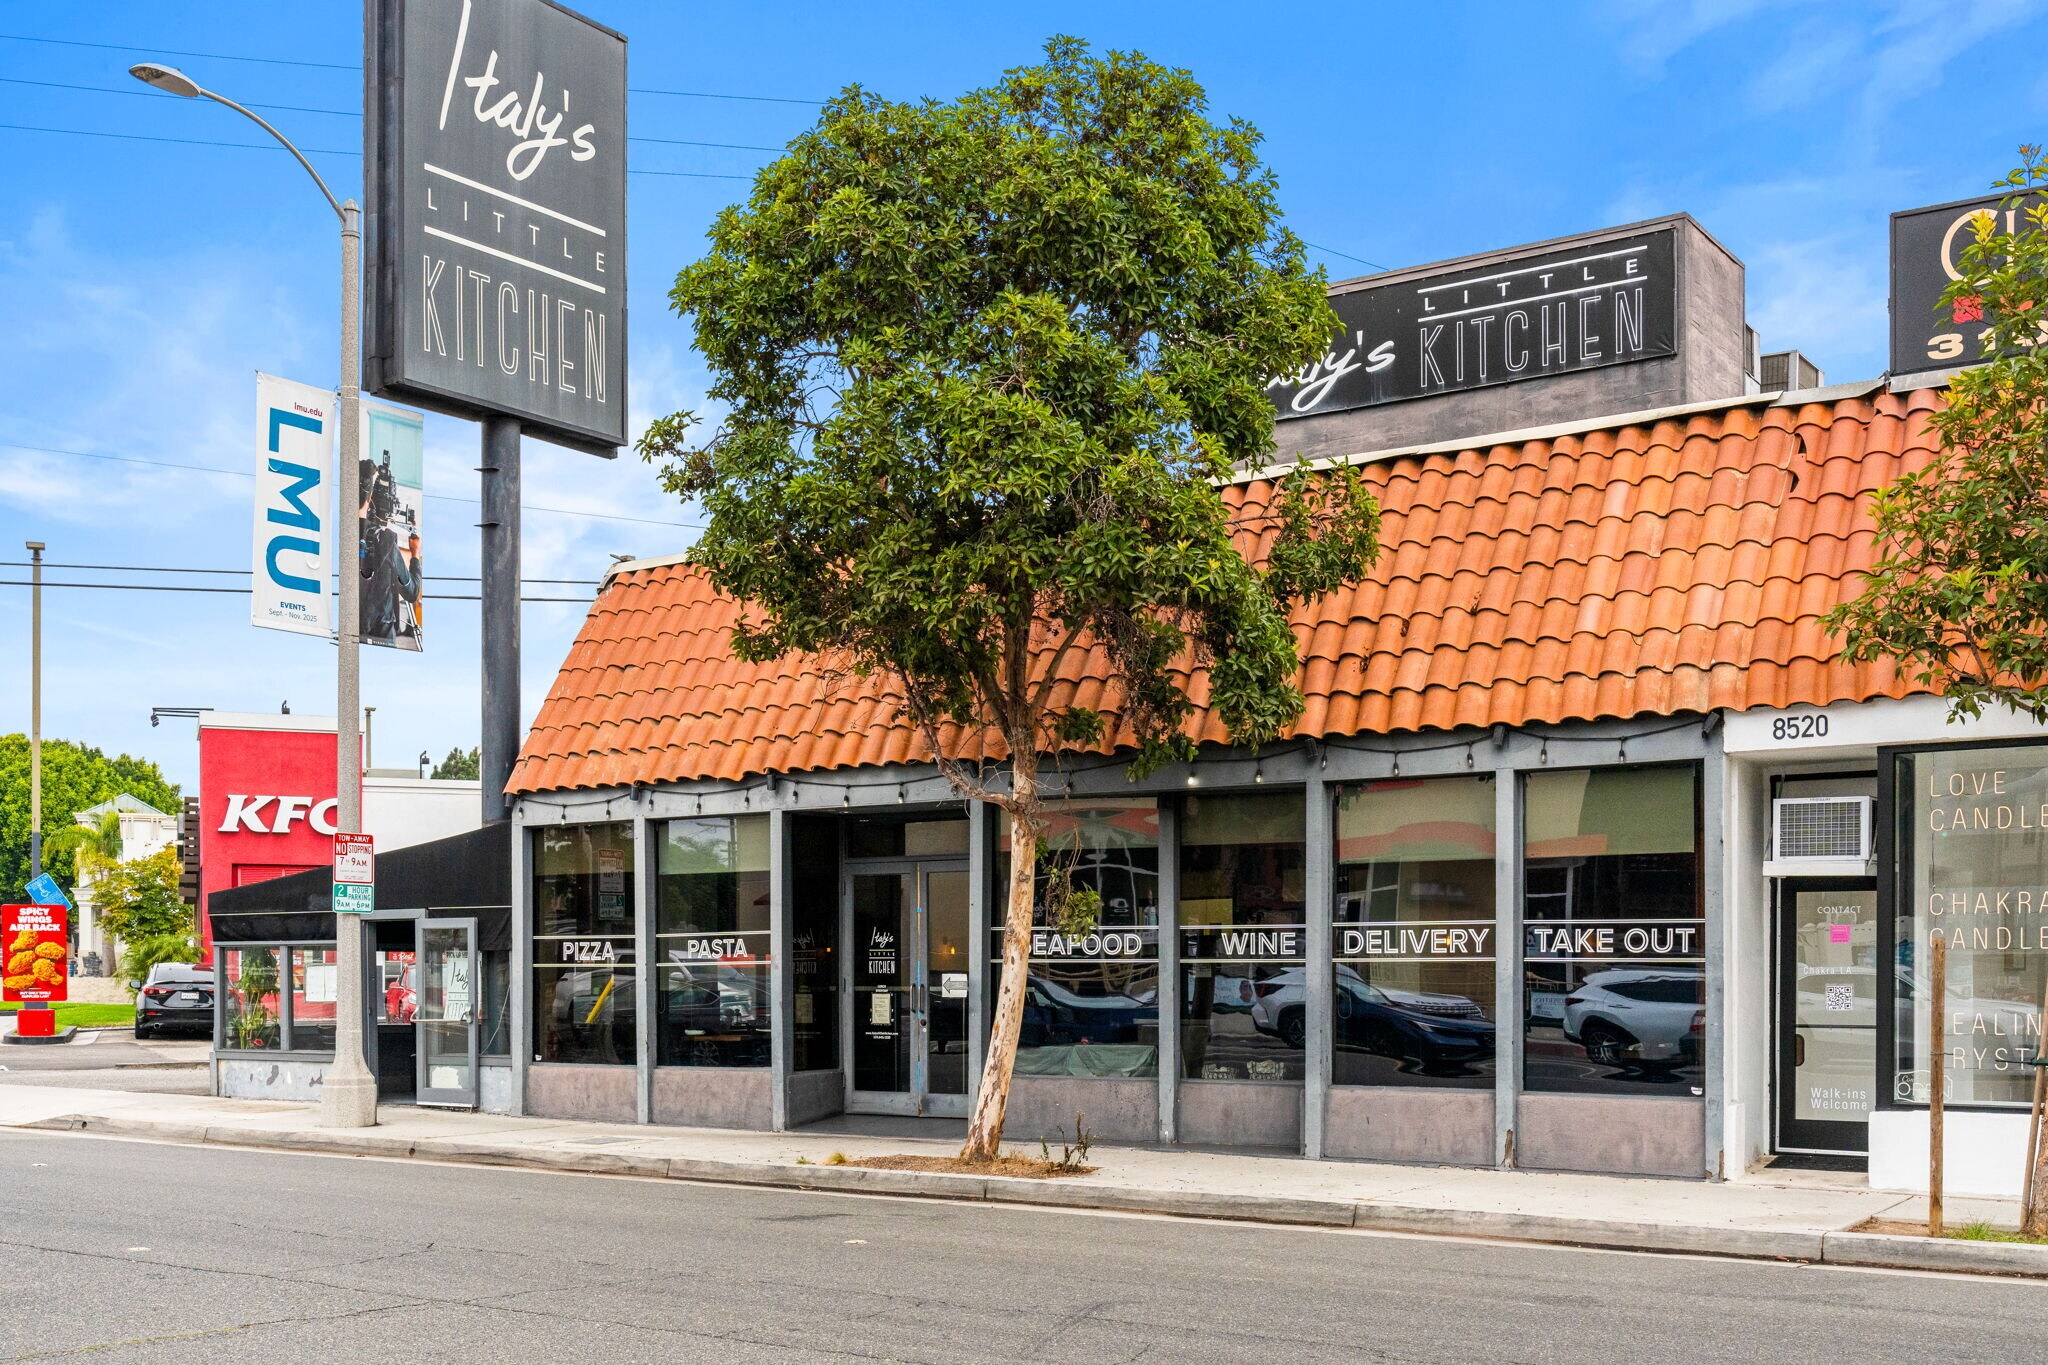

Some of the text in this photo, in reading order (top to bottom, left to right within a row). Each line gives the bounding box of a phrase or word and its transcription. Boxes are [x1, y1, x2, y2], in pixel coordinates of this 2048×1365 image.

[438, 0, 597, 182] Italy's
[428, 187, 605, 273] LITTLE
[1424, 258, 1639, 311] LITTLE
[423, 254, 606, 403] KITCHEN
[1420, 287, 1643, 389] KITCHEN
[294, 402, 323, 417] lmu.edu
[265, 407, 323, 595] LMU
[268, 608, 283, 617] Sept.
[288, 611, 302, 620] Nov.
[303, 613, 318, 622] 2025
[280, 601, 306, 612] EVENTS
[1772, 714, 1829, 740] 8520
[1930, 771, 2006, 797] LOVE
[217, 794, 338, 835] KFC
[335, 842, 372, 855] NO STOPPING
[339, 857, 345, 866] 7
[337, 884, 345, 897] 2
[348, 893, 371, 902] PARKING
[17, 915, 53, 924] WINGS
[19, 907, 50, 916] SPICY
[1817, 905, 1862, 914] CONTACT
[9, 923, 60, 932] ARE BACK
[870, 926, 894, 948] Italy's
[562, 941, 615, 961] PIZZA
[687, 938, 748, 959] PASTA
[1028, 933, 1142, 956] EAFOOD
[1221, 931, 1296, 956] WINE
[1344, 928, 1490, 954] DELIVERY
[1534, 927, 1696, 954] TAKE OUT
[868, 960, 896, 974] KITCHEN
[1803, 965, 1835, 975] Chakra
[1952, 1012, 2042, 1036] EALIN
[1952, 1046, 2041, 1071] RYST
[1811, 1087, 1866, 1100] Walk-ins
[1811, 1098, 1868, 1111] Welcome
